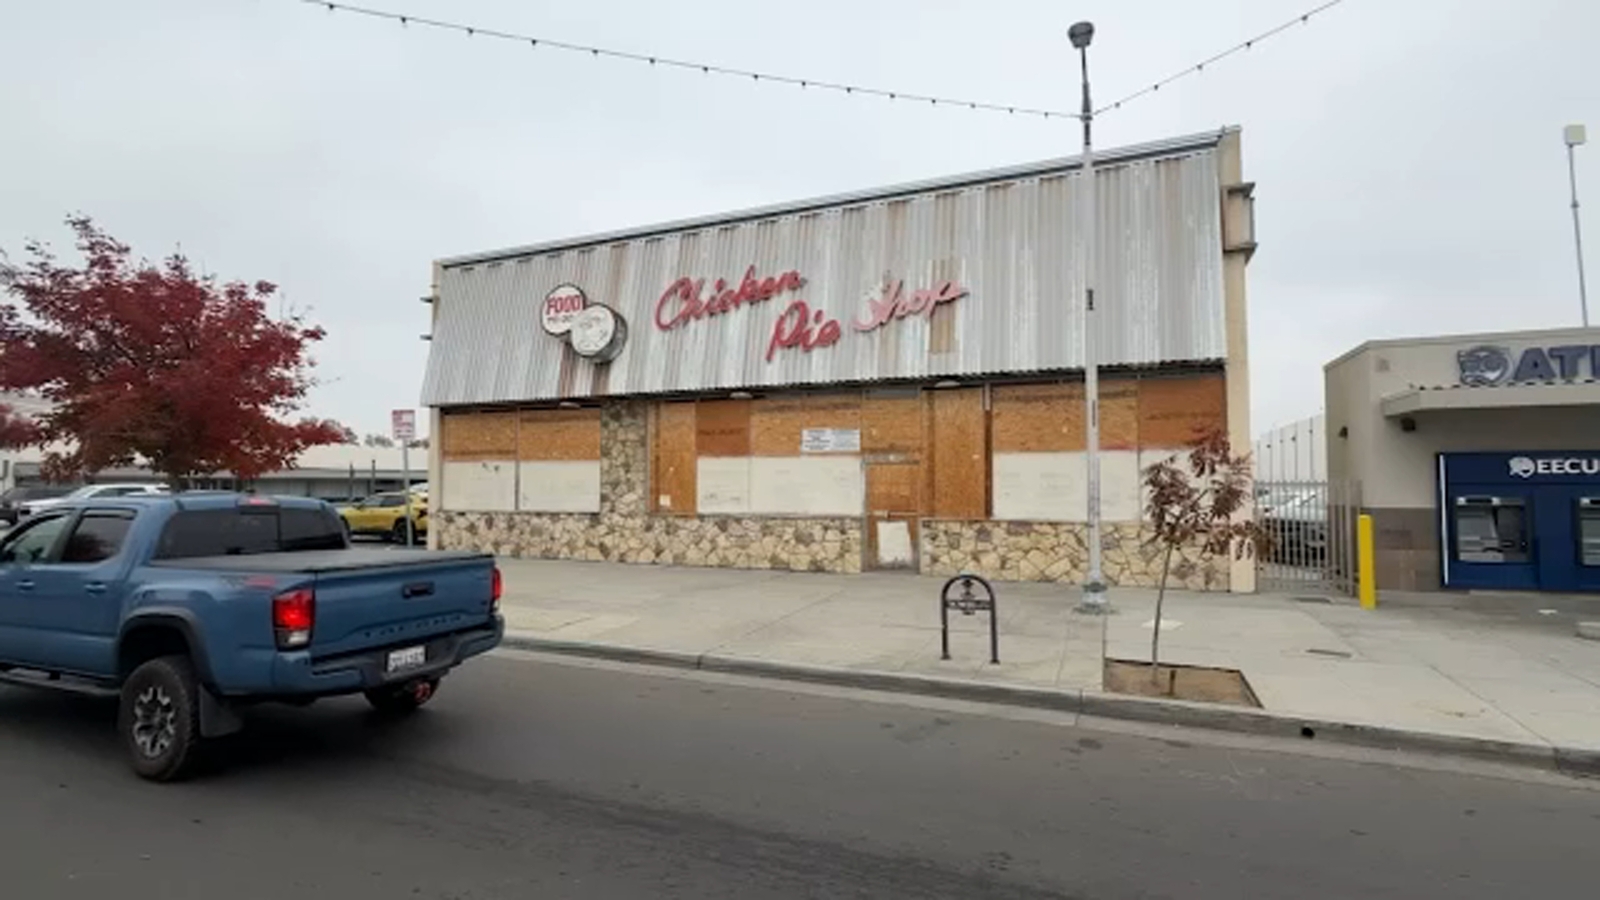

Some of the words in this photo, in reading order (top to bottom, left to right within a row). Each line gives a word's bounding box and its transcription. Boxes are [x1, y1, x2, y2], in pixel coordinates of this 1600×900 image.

[546, 294, 581, 315] FOOD
[655, 264, 807, 331] Chicken
[766, 300, 841, 361] Pie
[1513, 345, 1600, 381] AT
[1537, 459, 1599, 473] EECU
